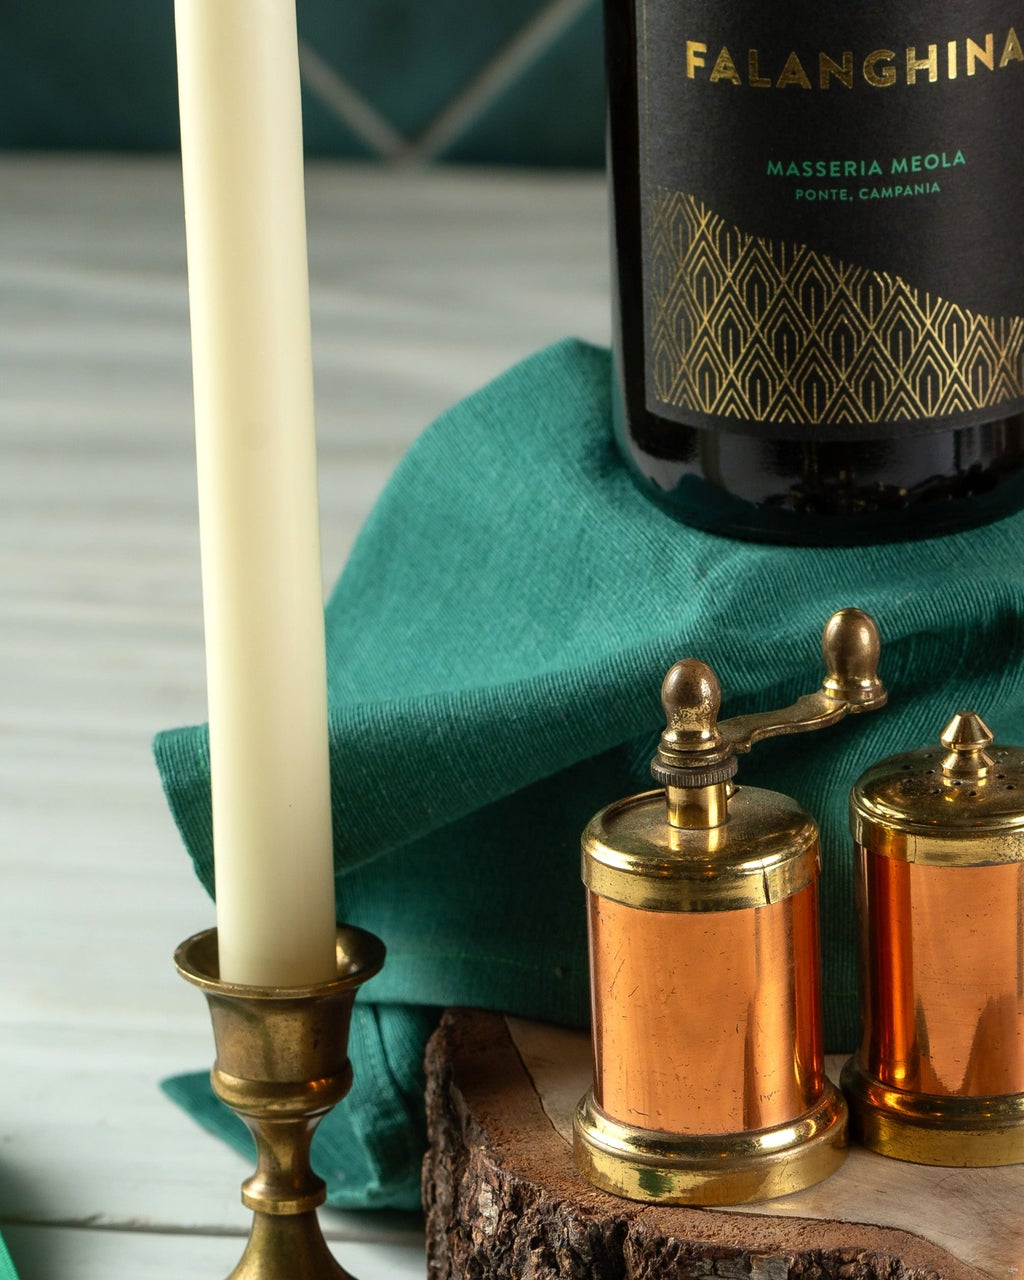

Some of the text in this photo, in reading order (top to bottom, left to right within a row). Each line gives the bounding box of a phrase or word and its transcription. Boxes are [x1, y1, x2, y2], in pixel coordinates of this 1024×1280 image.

[766, 149, 967, 178] MASSERIA MEOLA
[795, 181, 941, 203] PONTE, CAMPANIA
